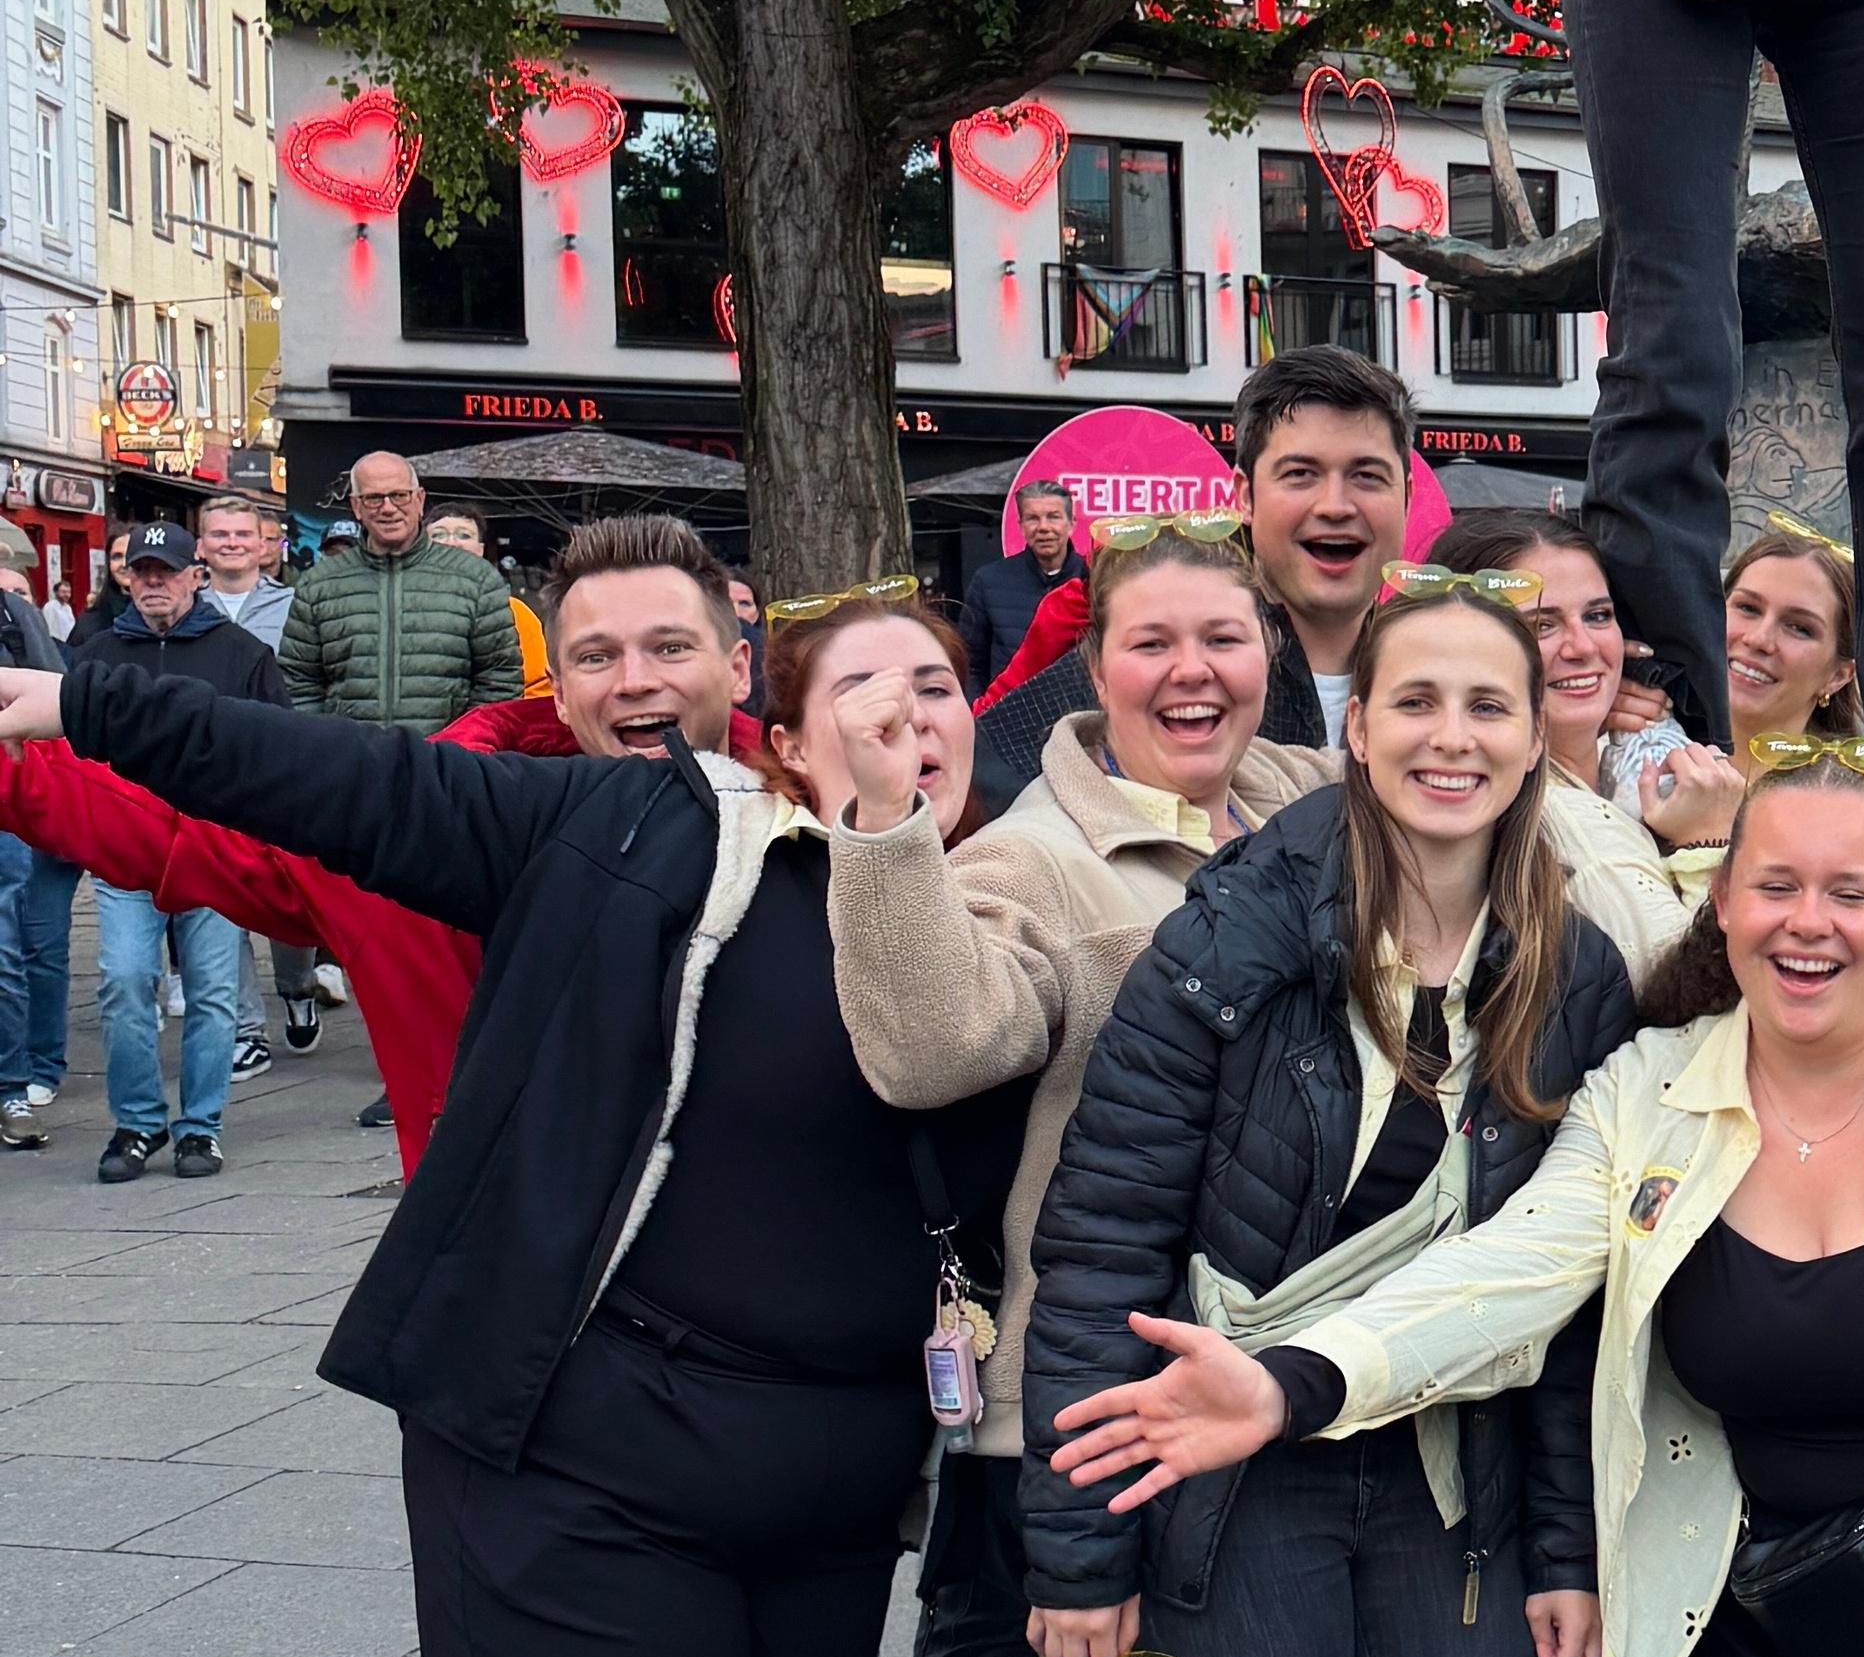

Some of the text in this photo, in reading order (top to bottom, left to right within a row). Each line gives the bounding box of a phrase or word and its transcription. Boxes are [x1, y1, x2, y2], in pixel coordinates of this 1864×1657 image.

[1763, 357, 1836, 388] in E
[464, 394, 603, 421] FRIEDA B.
[1731, 401, 1840, 430] nerna
[1422, 431, 1527, 453] FRIEDA B.
[1060, 476, 1199, 514] FEIERT
